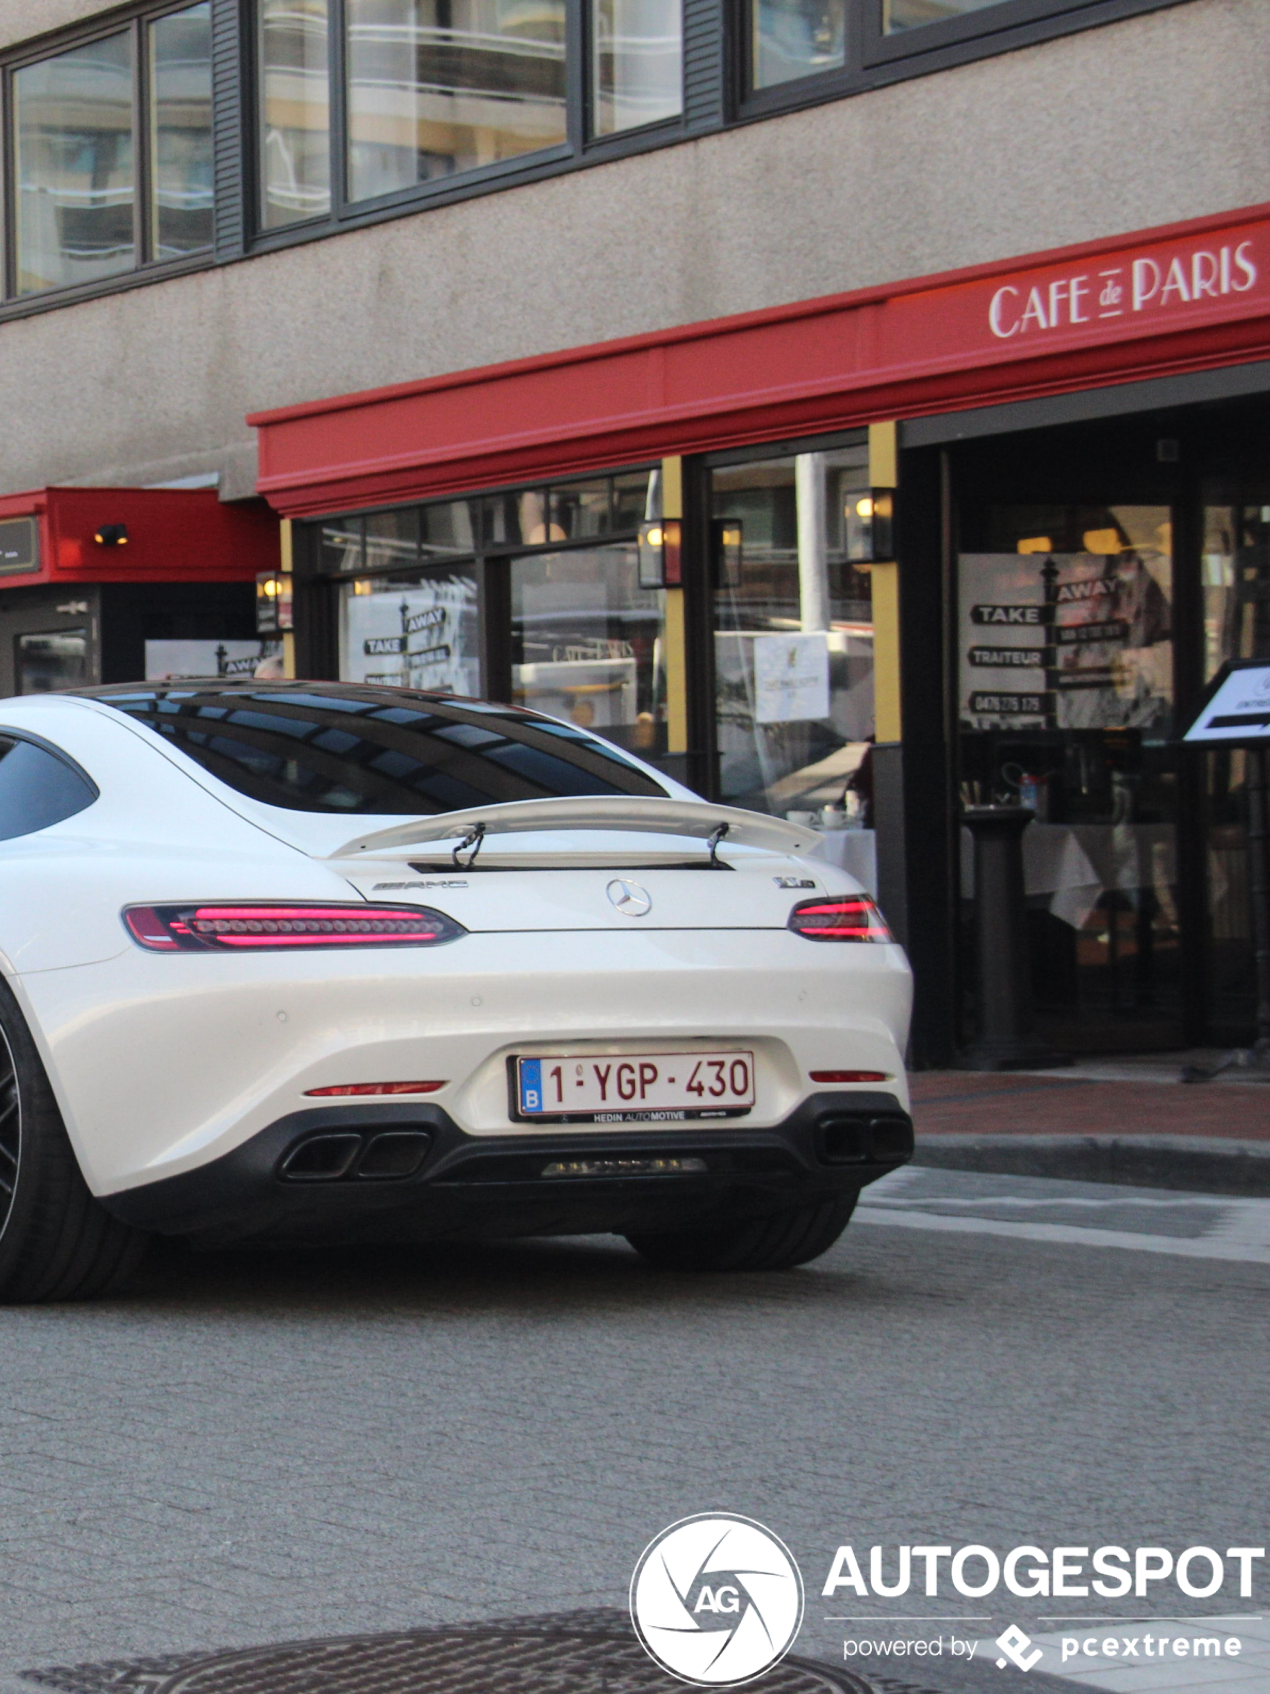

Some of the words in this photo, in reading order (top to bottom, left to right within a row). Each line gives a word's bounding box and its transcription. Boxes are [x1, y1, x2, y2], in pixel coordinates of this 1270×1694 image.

[988, 276, 1090, 338] CAFE
[1099, 279, 1123, 306] de
[1132, 241, 1257, 312] PARIS
[1058, 577, 1118, 602] AWAY
[409, 609, 443, 632] AWAY
[979, 607, 1040, 623] TAKE
[368, 639, 400, 653] TAKE
[973, 650, 1043, 665] TRAITEUR
[525, 1090, 539, 1109] B
[593, 1113, 623, 1123] HEDIN
[624, 1110, 685, 1122] AUTOMOTIVE
